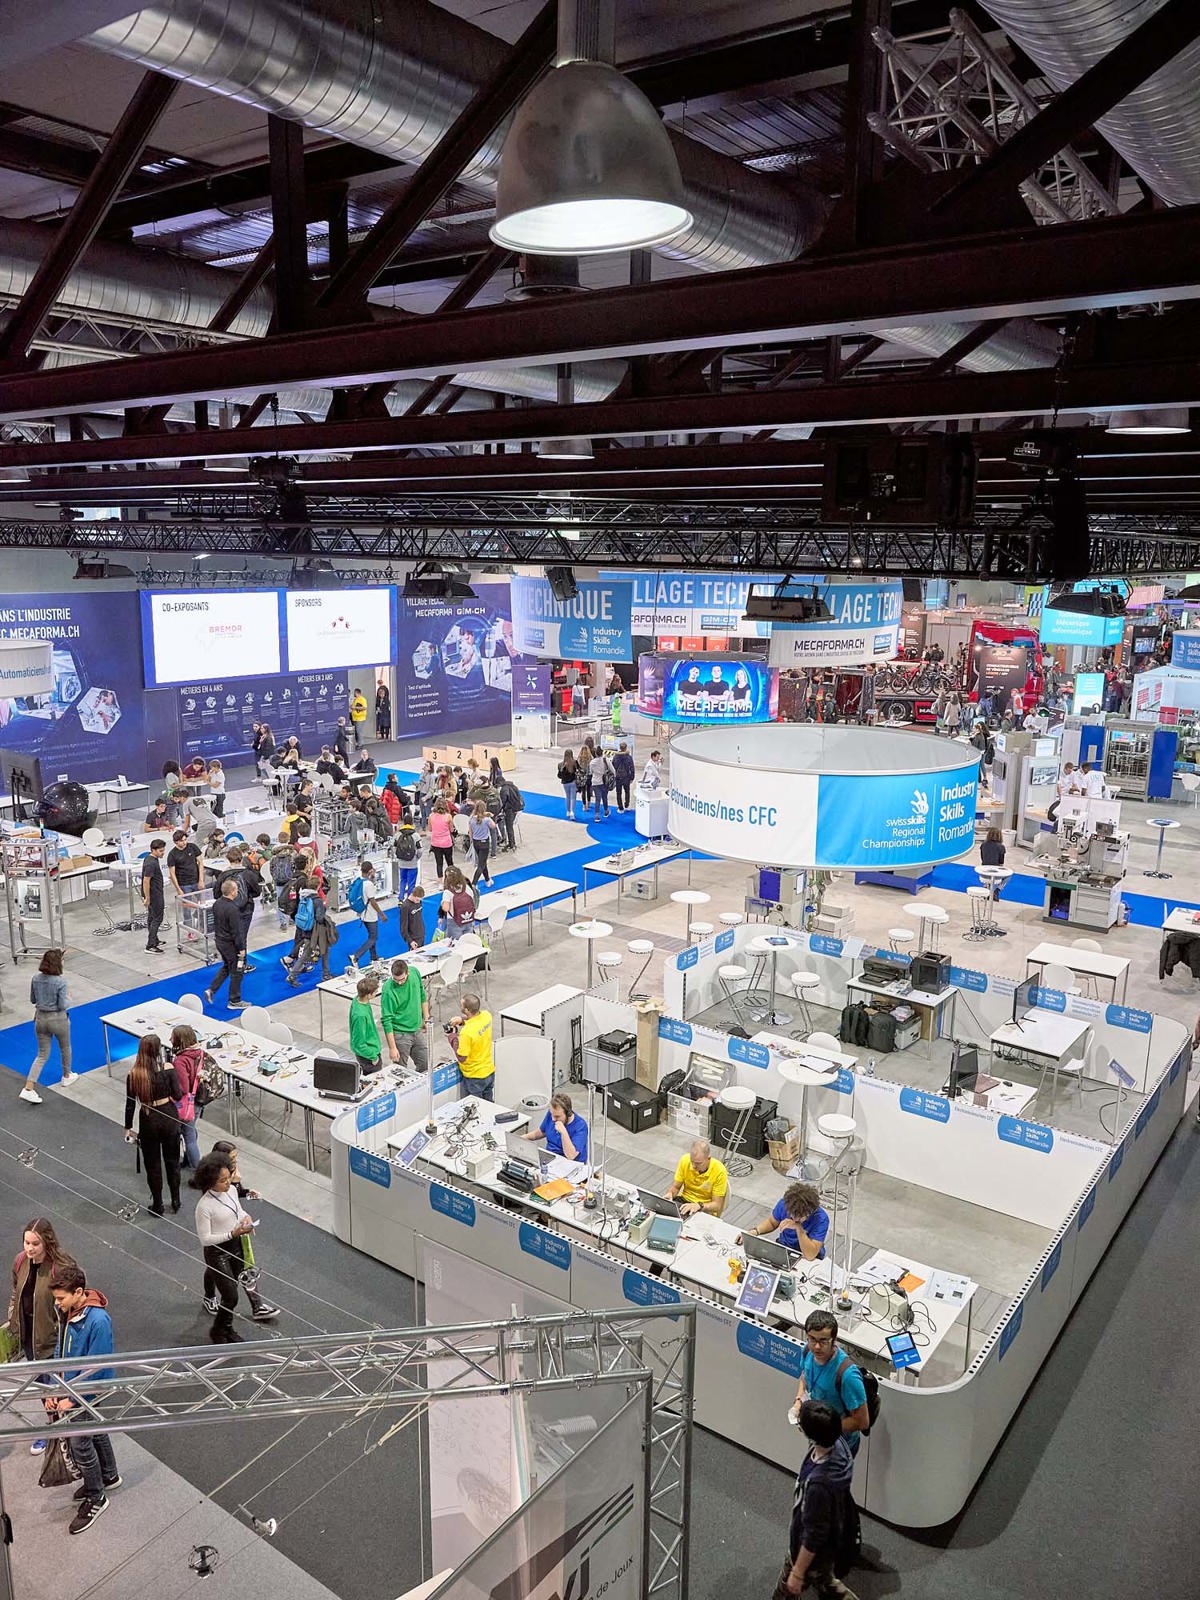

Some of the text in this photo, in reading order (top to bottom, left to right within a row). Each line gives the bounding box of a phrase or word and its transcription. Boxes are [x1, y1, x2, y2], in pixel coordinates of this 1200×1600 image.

[162, 601, 209, 612] CO-EXPOSANTS
[295, 598, 322, 608] SPONSORS
[18, 608, 71, 622] L'INDUSTRIE
[416, 608, 453, 618] MECAFORMA
[10, 625, 80, 640] MECAFORMA.CH
[593, 627, 622, 638] Industry
[593, 637, 611, 646] Skills
[794, 638, 864, 652] MECAFORMA.CH
[593, 645, 626, 656] Romandie
[676, 699, 753, 712] MECAFORMA
[432, 751, 437, 760] 3
[457, 750, 462, 759] 2
[484, 749, 488, 759] 1
[941, 780, 975, 802] Industry
[749, 805, 777, 827] CFC
[939, 801, 965, 823] Skills
[892, 826, 926, 839] Regional
[862, 837, 925, 850] Championships
[770, 1339, 797, 1358] Industry
[770, 1347, 787, 1359] Skills
[597, 1555, 634, 1597] de Joux
